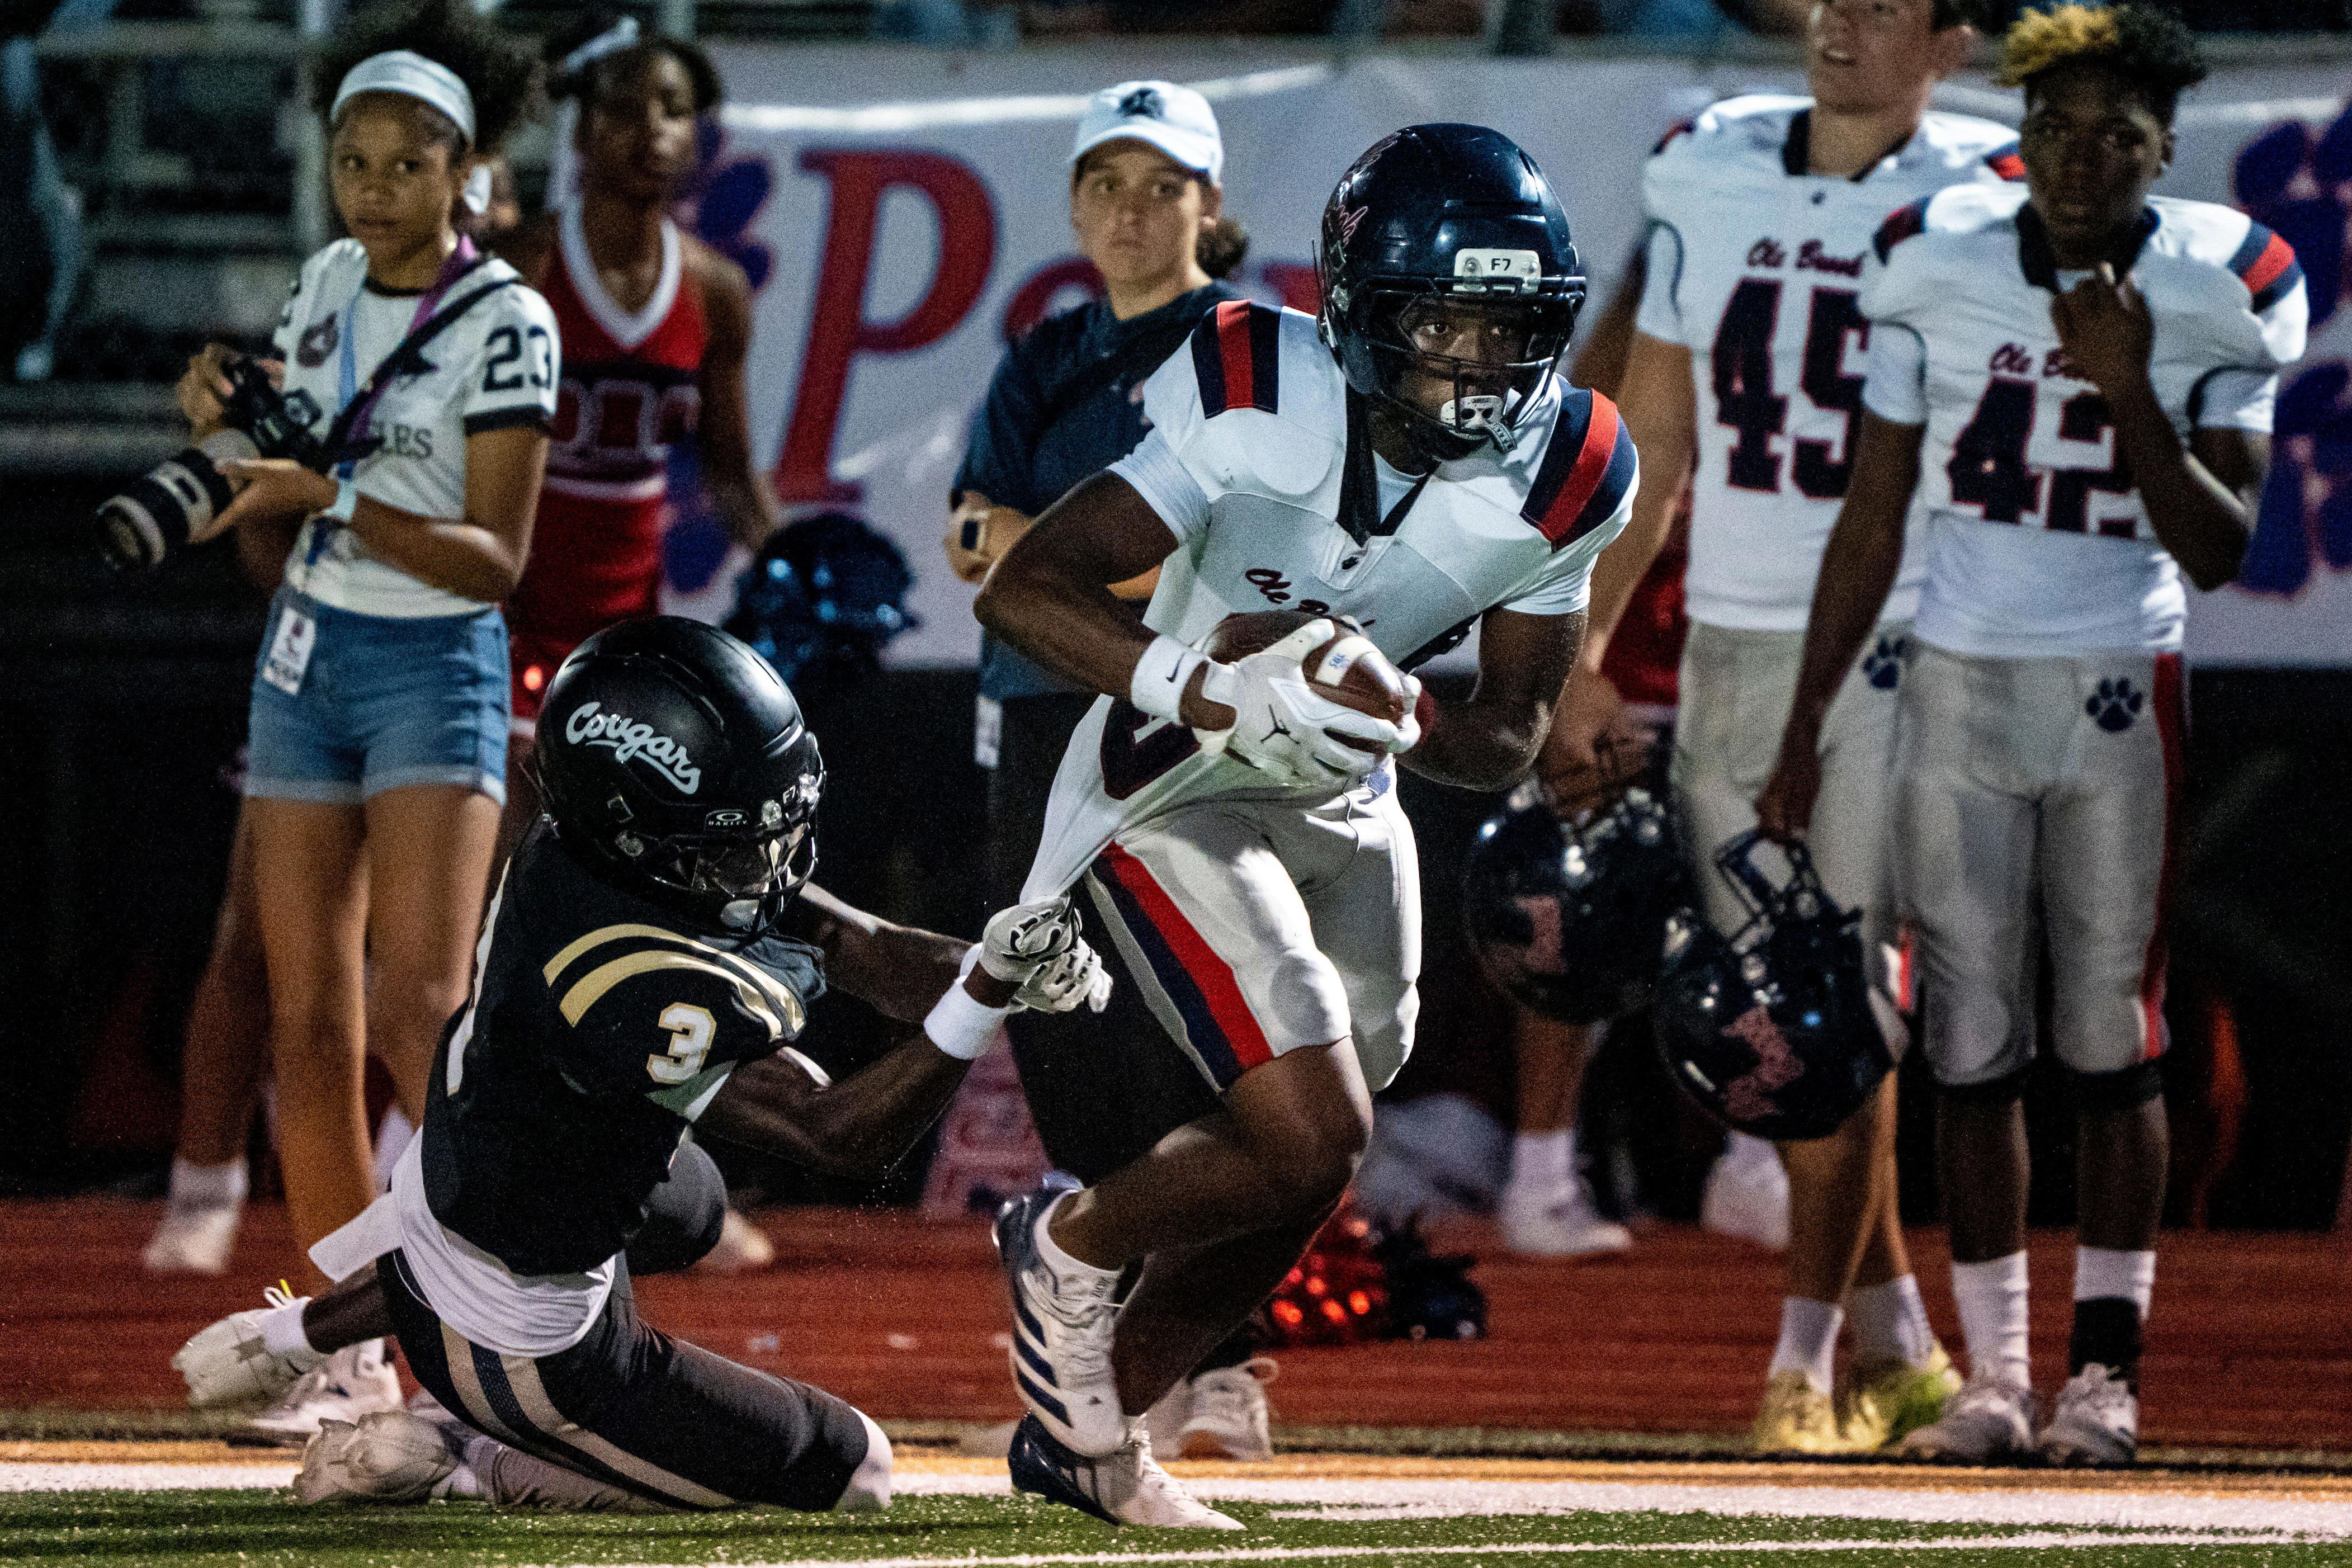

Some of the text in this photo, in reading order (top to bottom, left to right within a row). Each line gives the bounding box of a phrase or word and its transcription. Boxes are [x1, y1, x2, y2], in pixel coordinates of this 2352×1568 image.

[1491, 258, 1512, 271] F7
[483, 324, 552, 392] 23
[1711, 275, 1870, 499] 45
[1945, 376, 2140, 540] 42
[1245, 568, 1291, 604] Ole
[566, 701, 701, 795] Cougars
[782, 785, 796, 804] F7
[646, 1002, 717, 1084] 3
